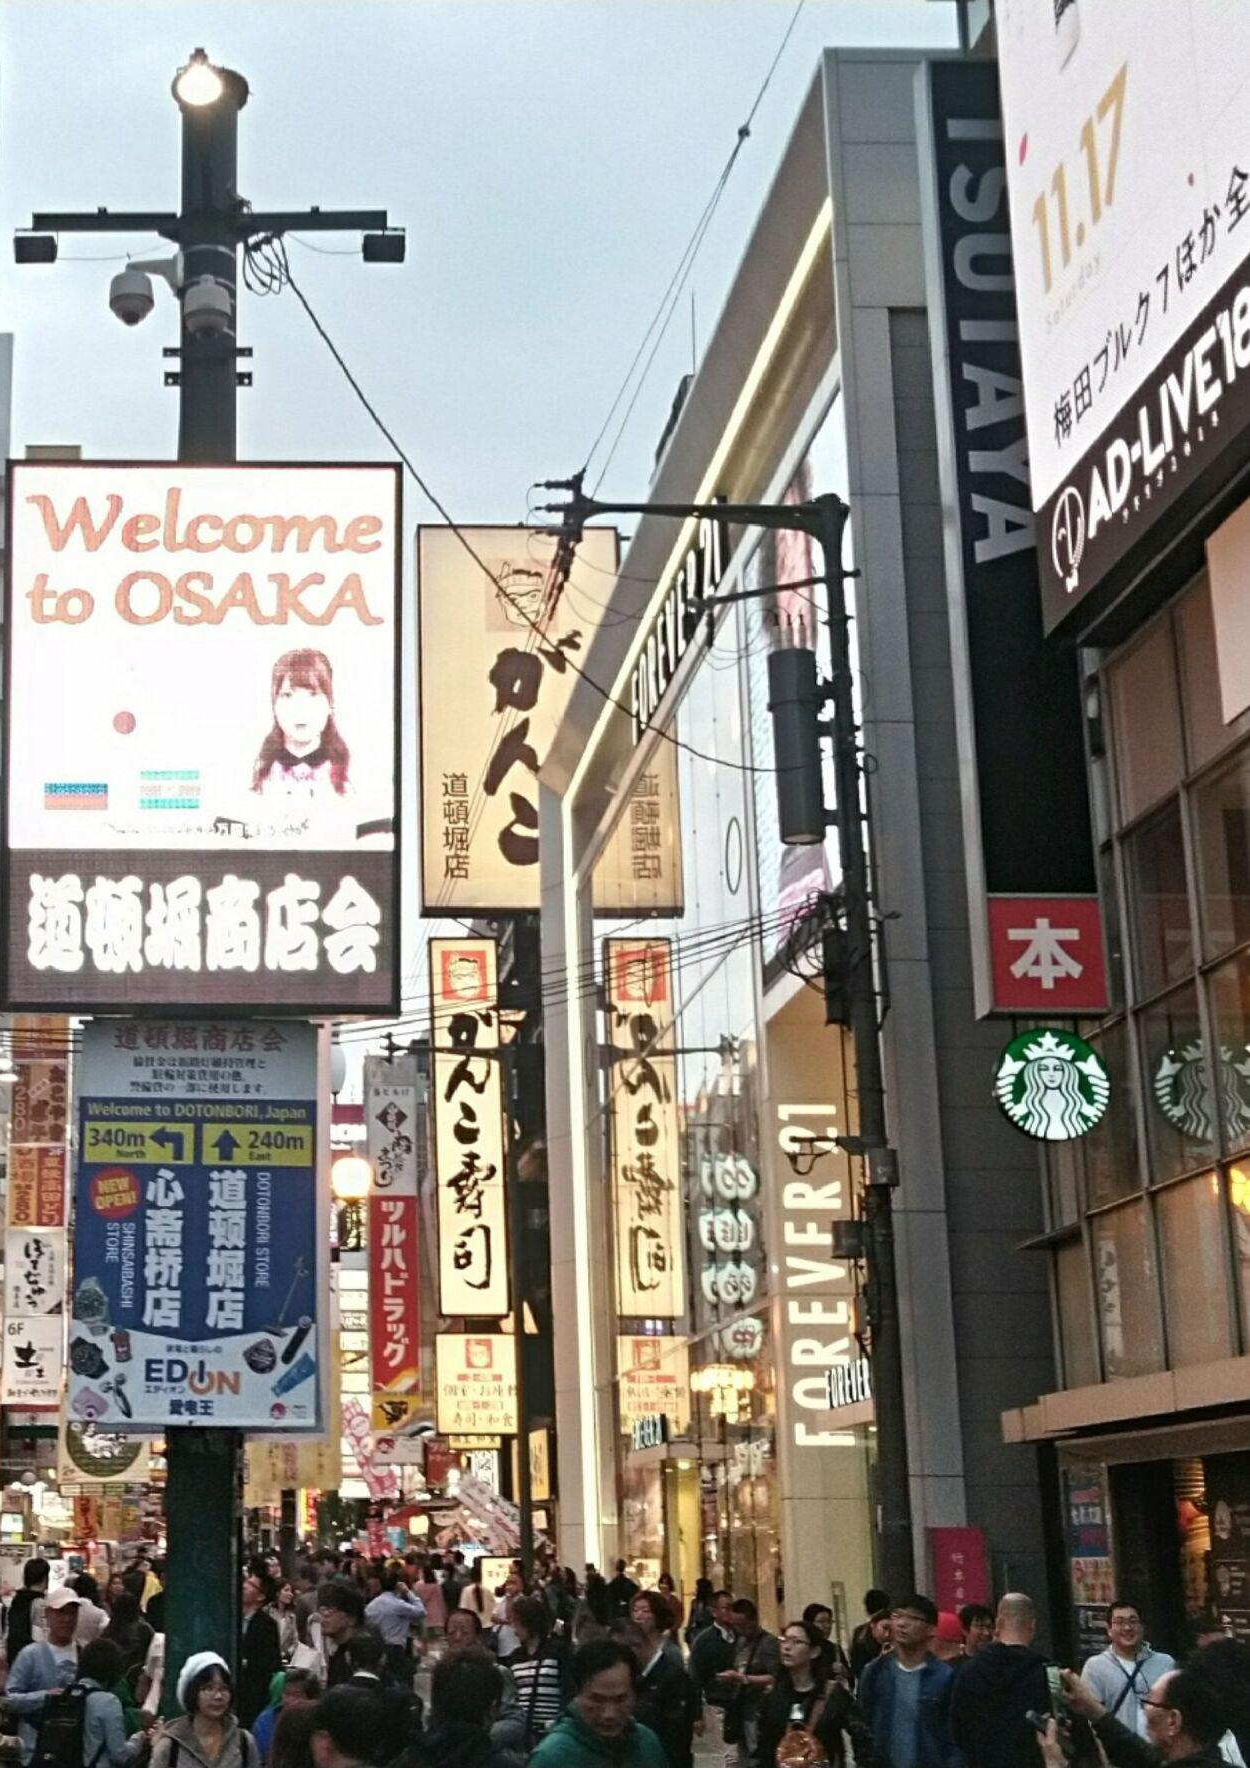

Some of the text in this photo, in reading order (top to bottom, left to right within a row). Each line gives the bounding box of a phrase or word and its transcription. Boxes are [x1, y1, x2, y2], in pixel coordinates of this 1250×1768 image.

[1031, 60, 1128, 294] 11.17
[26, 487, 384, 554] Welcome
[26, 570, 385, 627] to OSAKA
[442, 773, 470, 880] 道頓堀店
[28, 872, 382, 974] 道頓堀商店会
[1007, 917, 1084, 990] 本
[114, 1025, 288, 1052] 道頓堀商店会
[88, 1103, 151, 1116] Welcome
[156, 1105, 170, 1117] to
[88, 1128, 305, 1150] 340m 240m
[444, 1009, 497, 1290] がんこ寿司
[97, 1176, 130, 1192] NEW
[105, 1222, 120, 1264] STORE
[253, 1172, 271, 1288] DOTONBORI STORE
[119, 1222, 136, 1309] SHINSAIBASHI
[380, 1200, 407, 1368] ツルハドラッグ
[7, 1322, 25, 1335] 6F
[144, 1358, 241, 1396] EDION
